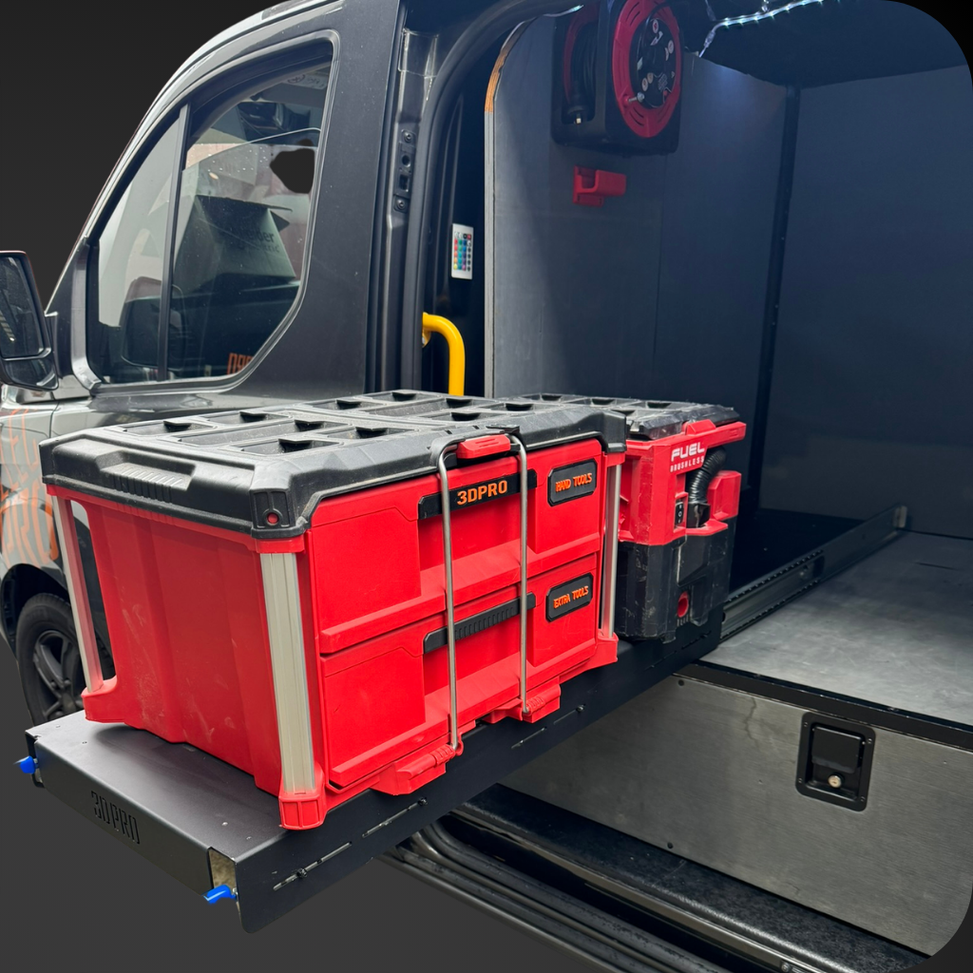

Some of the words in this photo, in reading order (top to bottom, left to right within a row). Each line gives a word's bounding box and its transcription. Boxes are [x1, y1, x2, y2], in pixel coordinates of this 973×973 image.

[671, 442, 706, 462] FUEL
[670, 455, 706, 473] BRUSHLESS
[574, 473, 593, 487] TOOLS
[457, 480, 508, 506] 3DPRO
[572, 587, 589, 602] TOOLS
